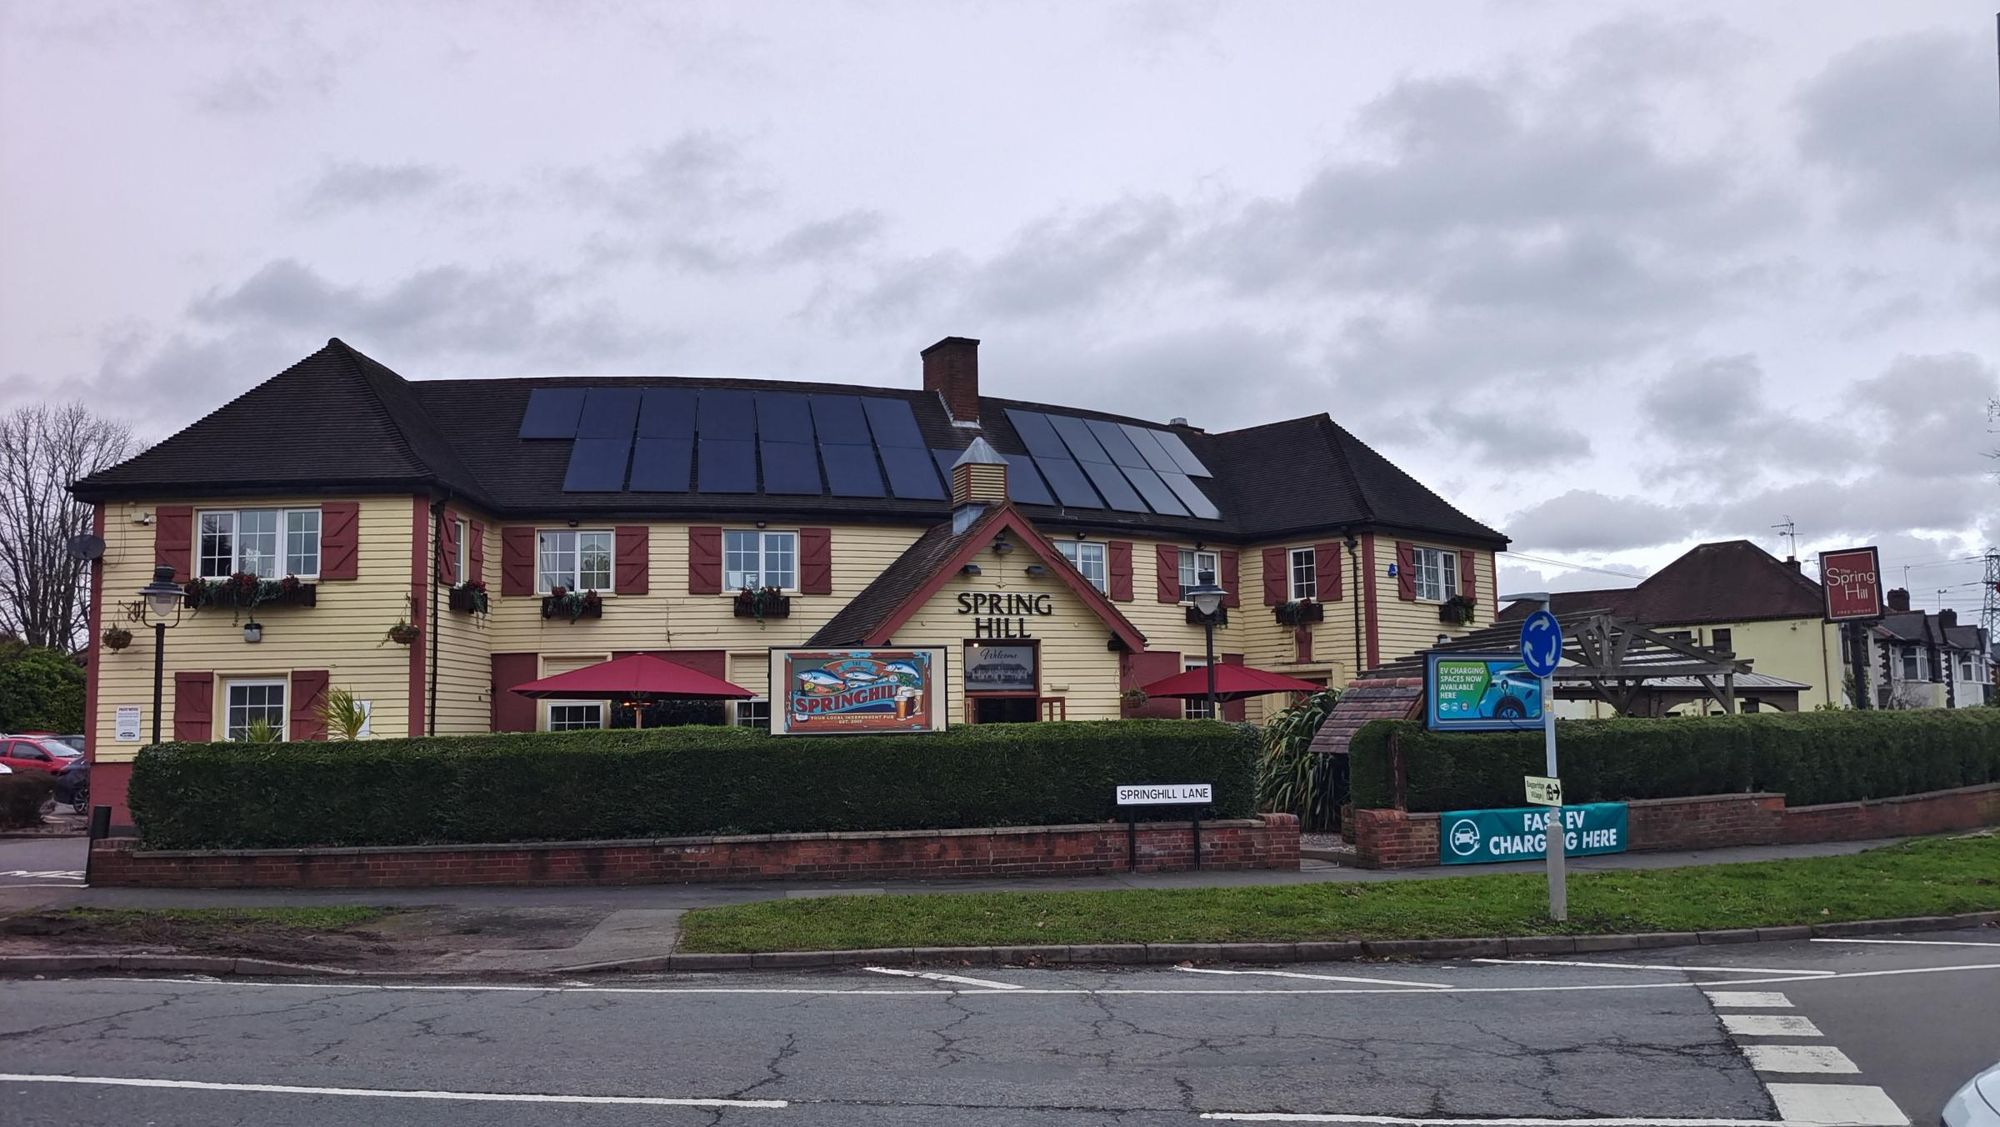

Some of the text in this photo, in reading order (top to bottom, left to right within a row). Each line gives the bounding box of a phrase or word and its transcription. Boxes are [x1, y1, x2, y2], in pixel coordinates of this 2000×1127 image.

[1827, 568, 1876, 587] Spring
[1845, 583, 1868, 600] Hill
[957, 593, 1052, 616] SPRING
[975, 617, 1032, 638] HILL
[980, 648, 1018, 660] Welcome
[1440, 667, 1485, 675] EV CHARGING
[1440, 675, 1482, 683] SPACES NOW
[1440, 683, 1474, 691] AVAILABLE
[1440, 691, 1457, 699] HERE
[1120, 787, 1209, 800] SPRINGHILL LANE
[1523, 811, 1585, 832] FAS EV
[1489, 828, 1617, 856] CHARGG HERE
